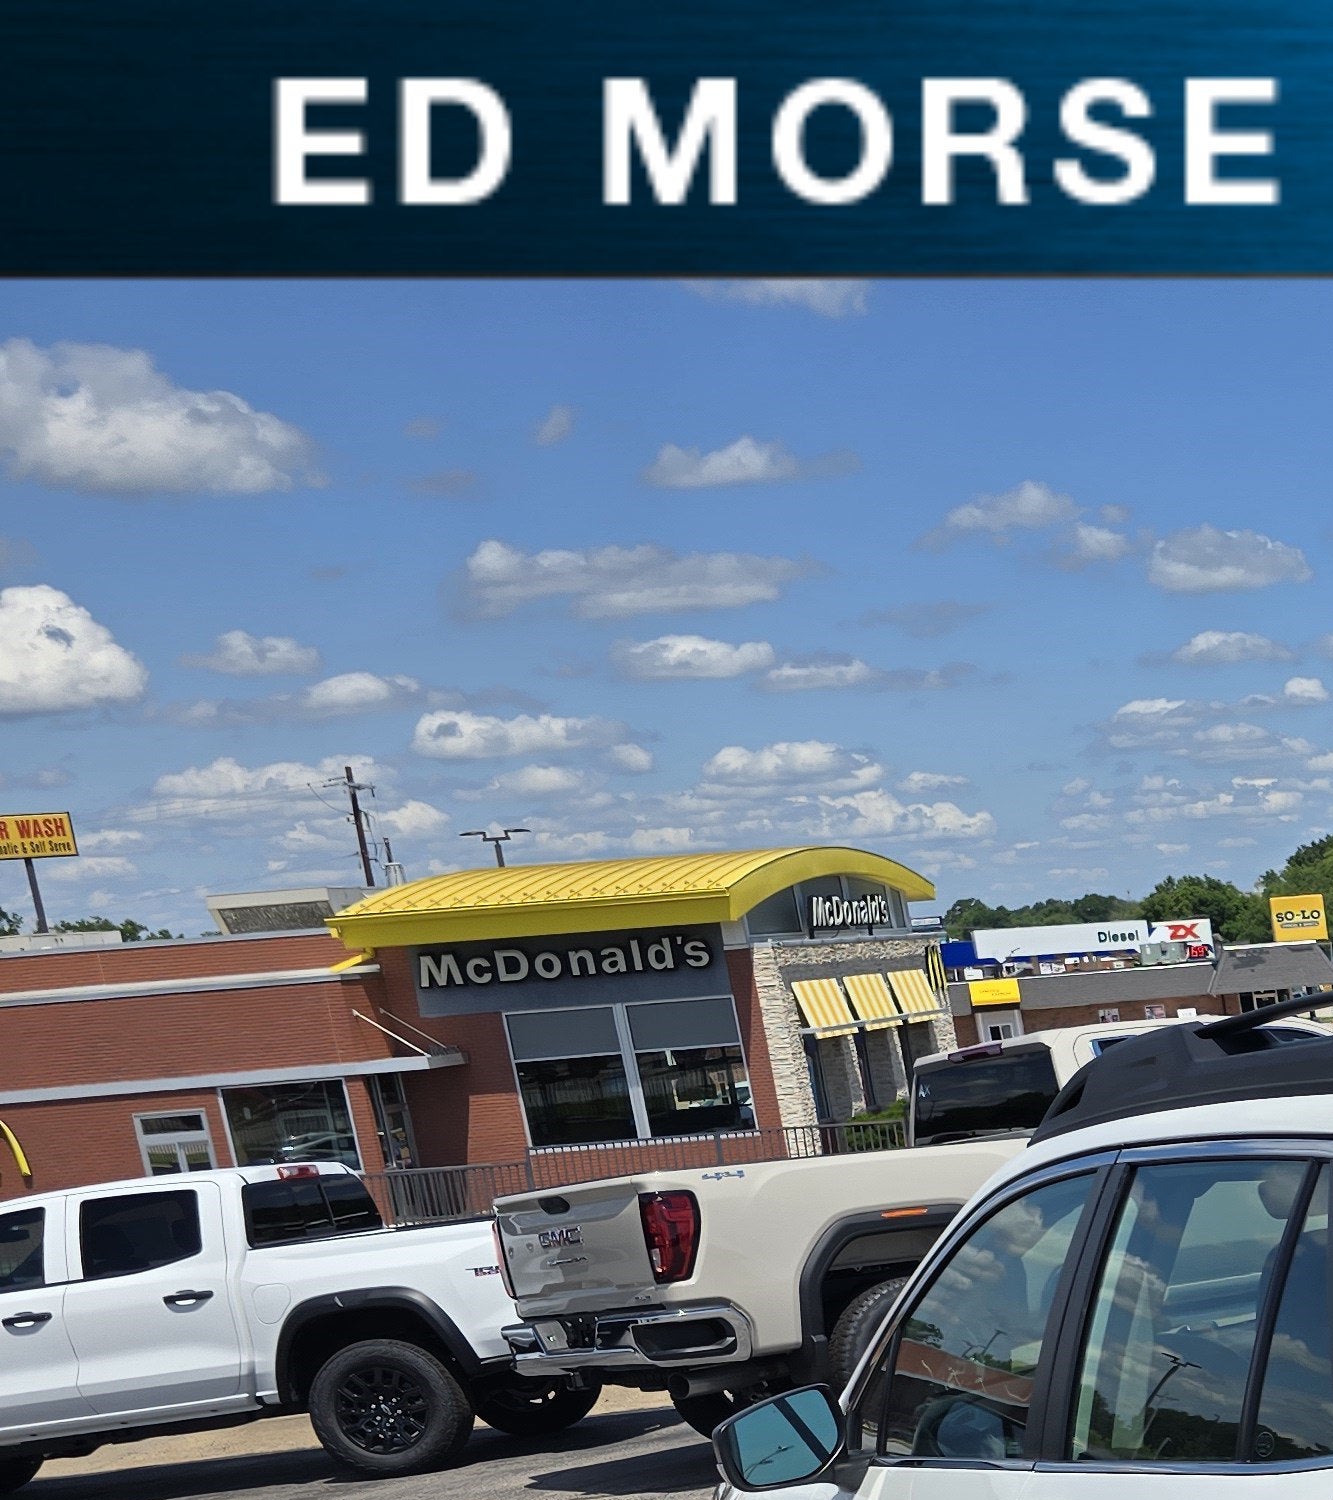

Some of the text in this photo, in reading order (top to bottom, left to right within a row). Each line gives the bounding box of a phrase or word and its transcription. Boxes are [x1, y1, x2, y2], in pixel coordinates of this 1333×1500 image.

[15, 817, 67, 839] WASH
[48, 839, 72, 853] Serve
[811, 895, 890, 928] McDonald's
[1275, 909, 1321, 923] SO-LO
[1097, 929, 1140, 944] Diesel
[418, 934, 712, 989] McDonald's
[538, 1224, 584, 1249] GMC
